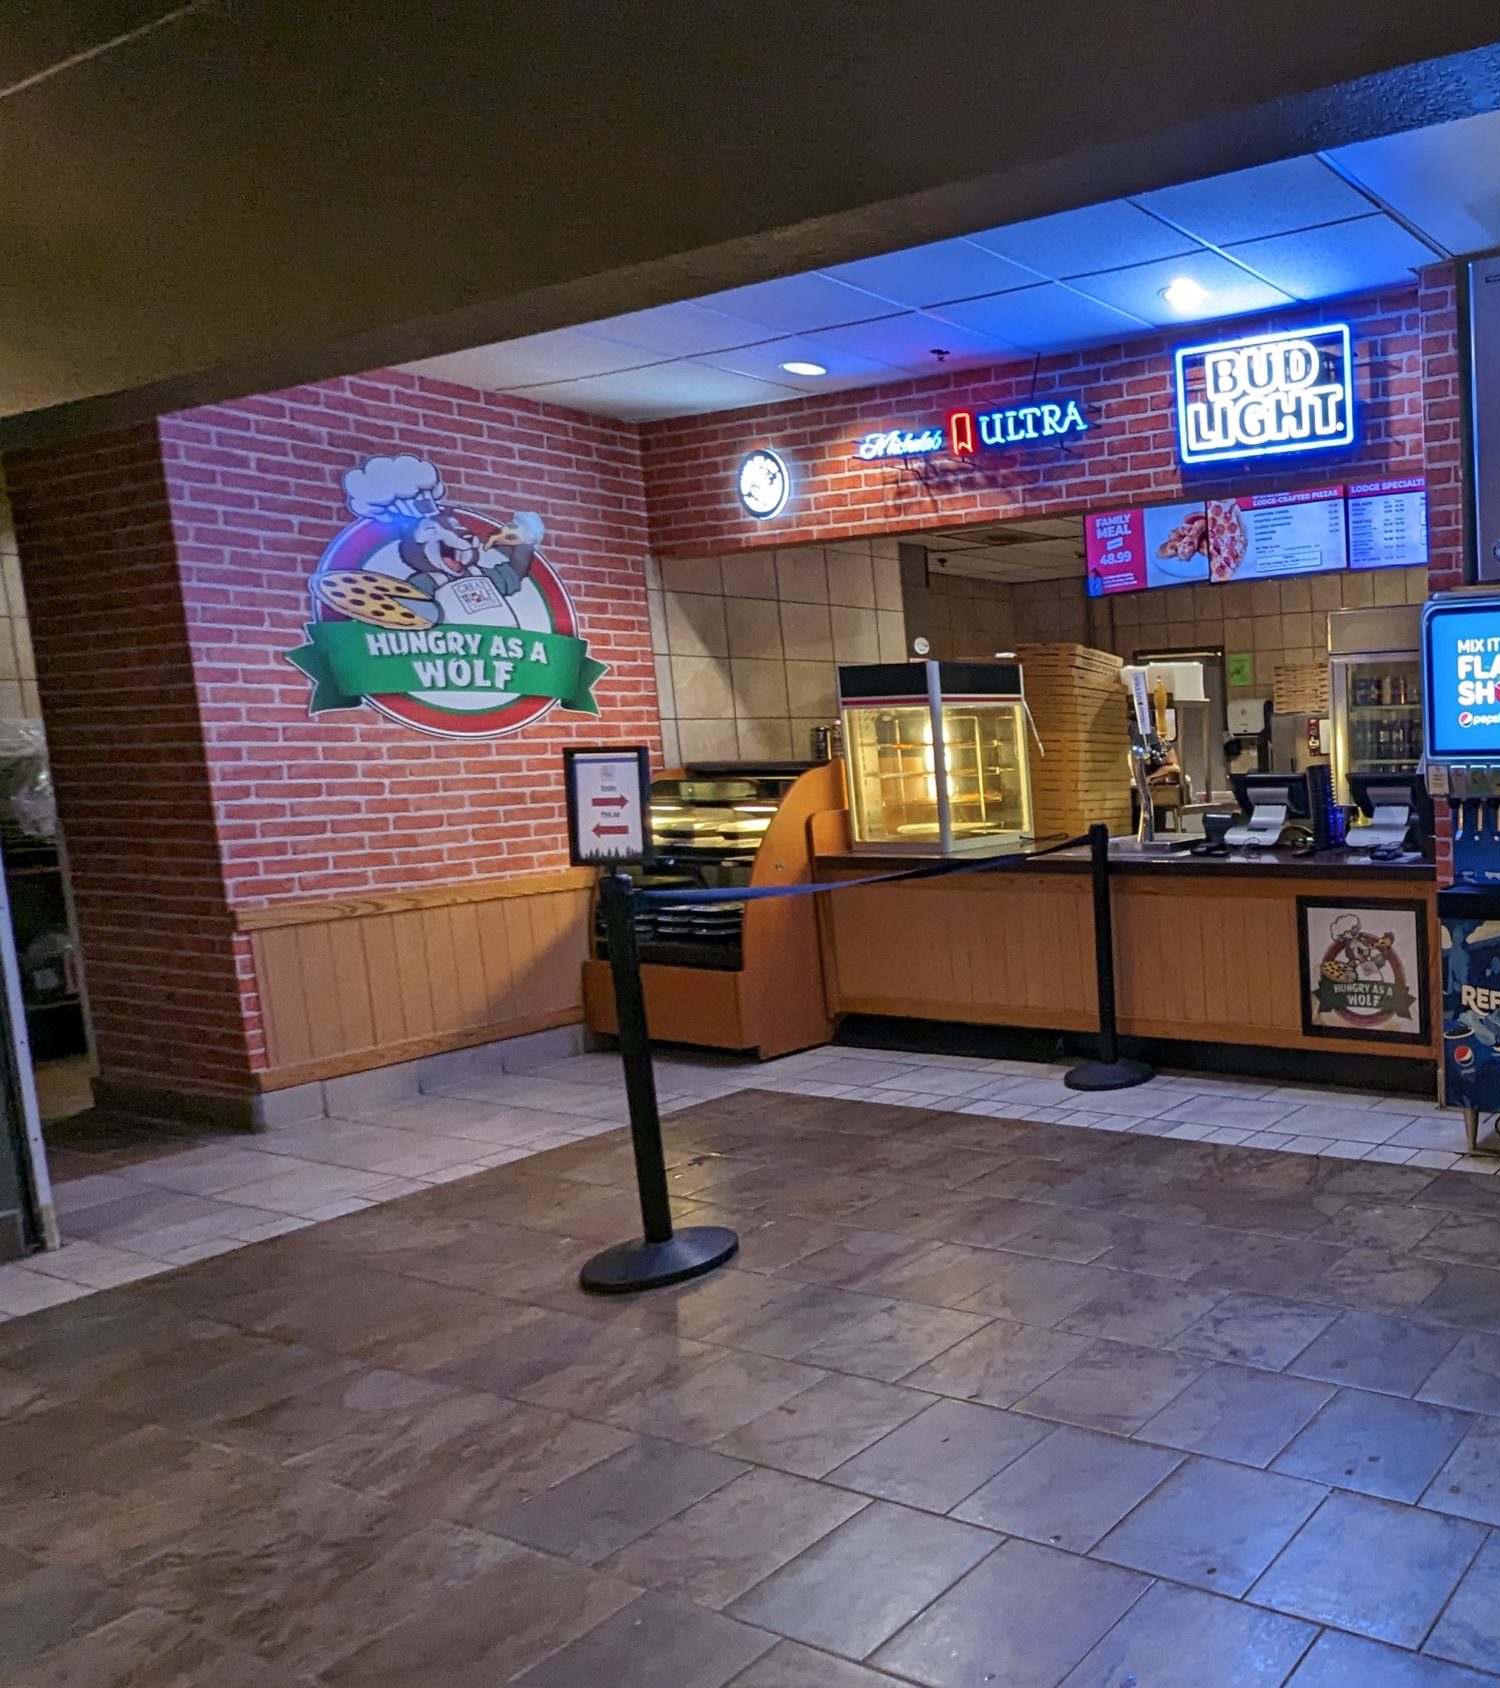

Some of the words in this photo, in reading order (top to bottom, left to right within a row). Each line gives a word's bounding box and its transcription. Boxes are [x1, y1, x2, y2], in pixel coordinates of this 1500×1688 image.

[1205, 340, 1319, 402] BUD
[978, 401, 1088, 445] ULTRA
[1187, 384, 1344, 451] LIGHT
[859, 430, 943, 460] Michelob
[1311, 489, 1338, 500] PIZZAS
[1351, 483, 1380, 494] LODGE
[1095, 513, 1131, 528] FAMILY
[1096, 523, 1132, 539] MEAL
[1100, 550, 1132, 566] 48.99
[366, 631, 482, 657] HUNGRY
[490, 635, 524, 660] AS
[530, 641, 548, 665] A
[1457, 638, 1484, 653] MIX
[413, 658, 515, 690] WOLF
[1333, 983, 1370, 994] HUNGRY
[1372, 984, 1385, 995] AS
[1386, 987, 1394, 997] A
[1347, 994, 1381, 1007] WOLF
